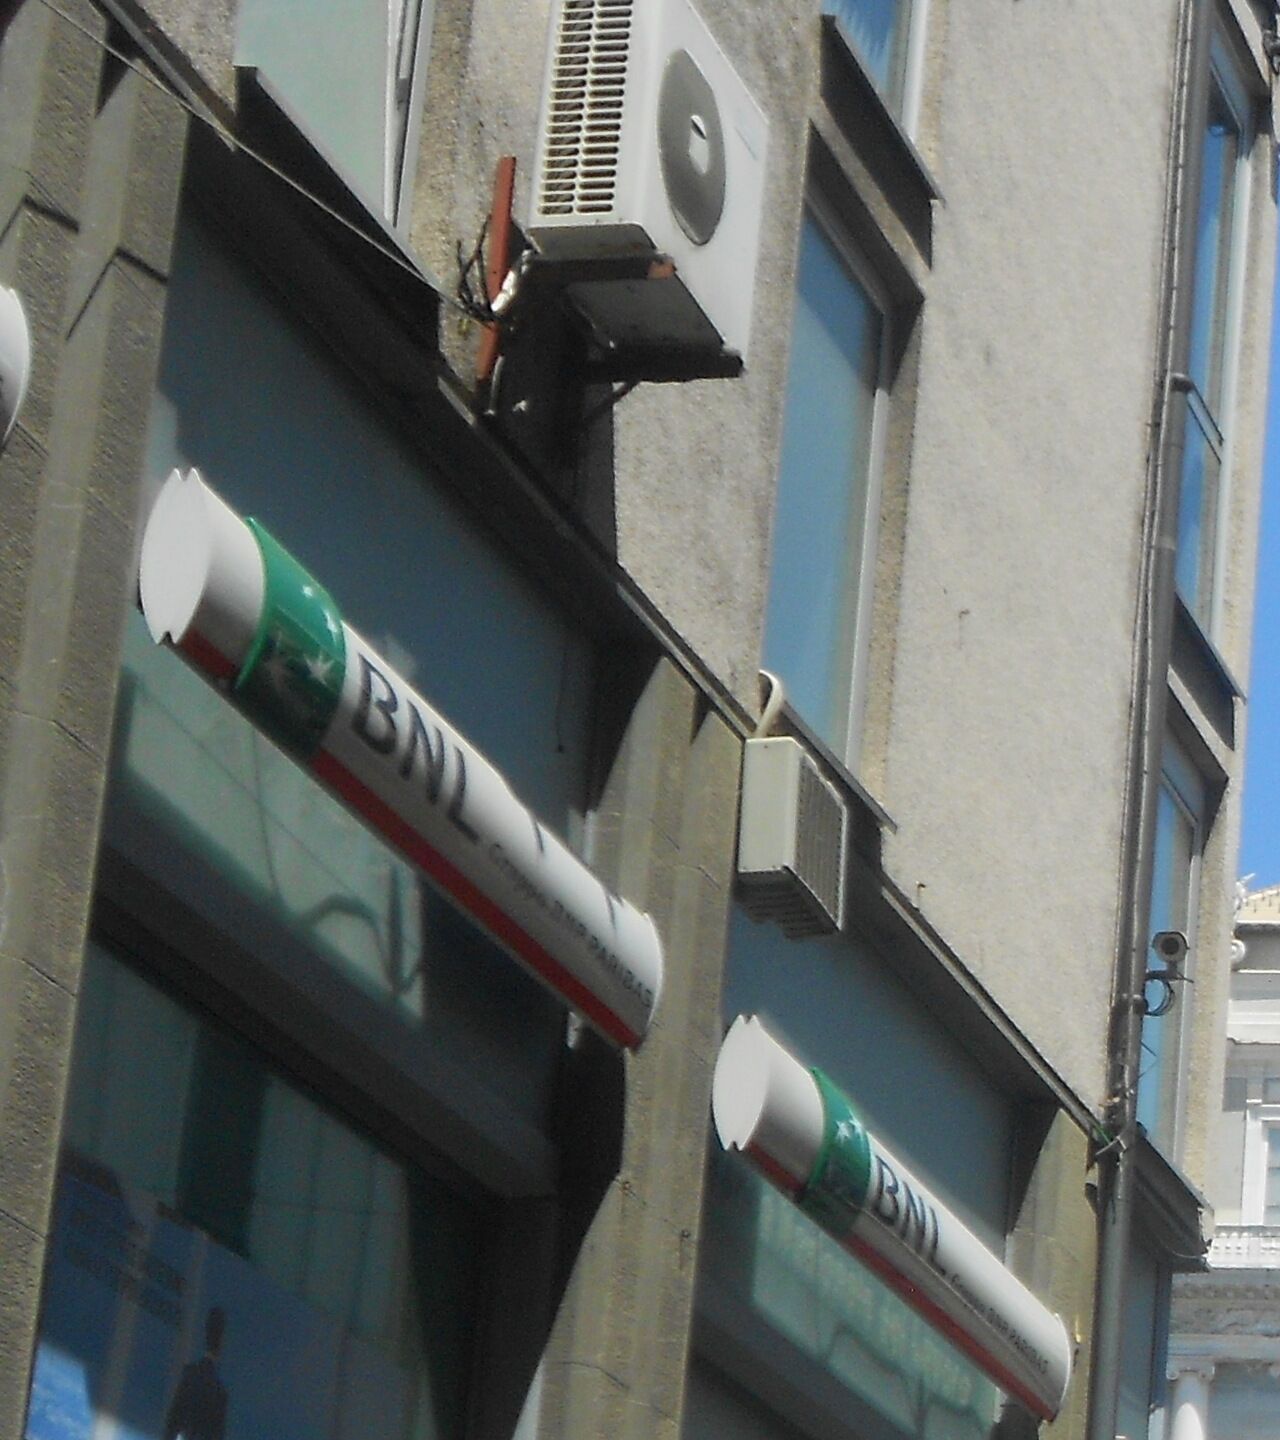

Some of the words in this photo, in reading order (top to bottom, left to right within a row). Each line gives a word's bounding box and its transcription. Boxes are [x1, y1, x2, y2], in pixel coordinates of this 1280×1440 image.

[351, 655, 479, 845] BNL
[588, 934, 653, 1008] PARIBAS
[874, 1154, 947, 1276] BNL
